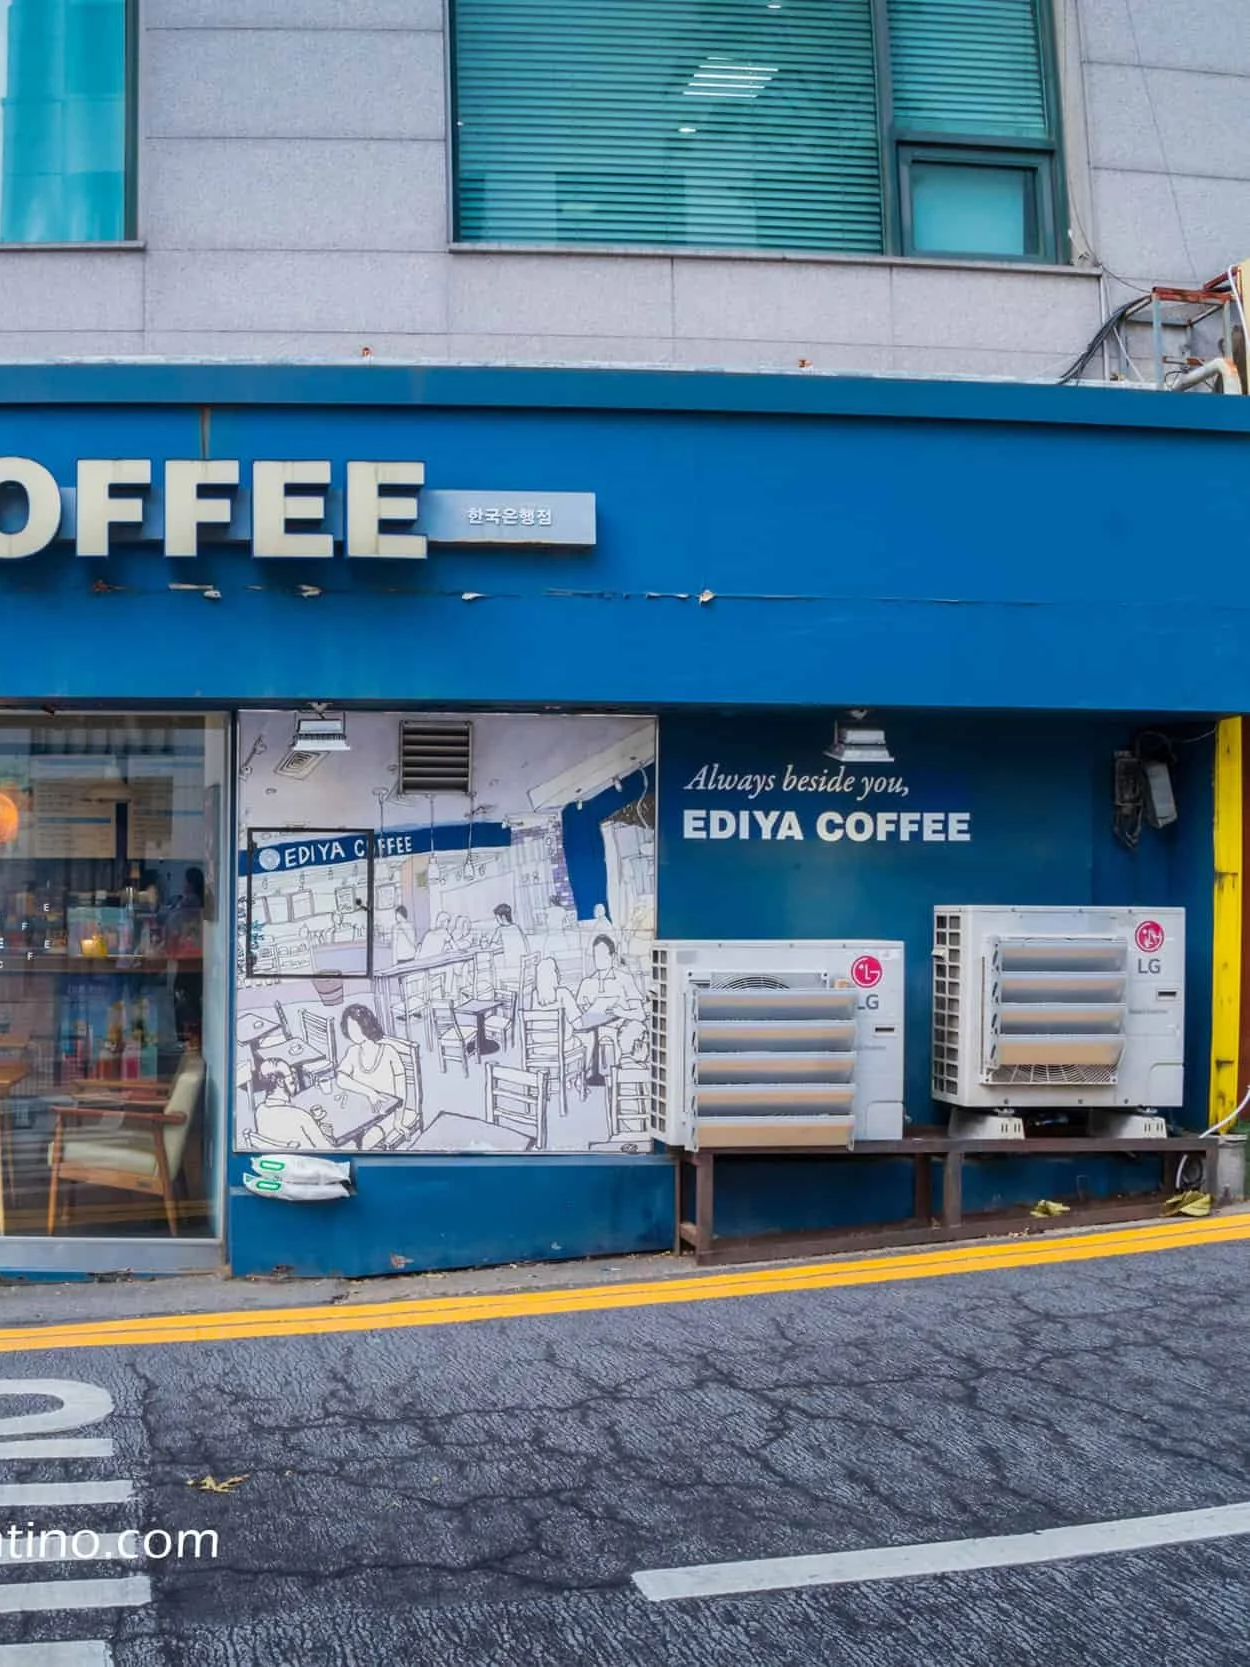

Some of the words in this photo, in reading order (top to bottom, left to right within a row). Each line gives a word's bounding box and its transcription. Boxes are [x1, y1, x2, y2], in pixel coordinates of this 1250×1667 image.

[467, 507, 552, 526] 한국은행점
[683, 763, 775, 800] Always
[782, 765, 856, 793] beside
[857, 772, 910, 801] you,
[683, 809, 804, 841] EDIYA
[816, 811, 971, 842] COFFEE
[285, 840, 345, 867] EDIYA
[354, 836, 412, 858] CFFEE
[1138, 958, 1161, 974] LG
[857, 994, 879, 1010] G
